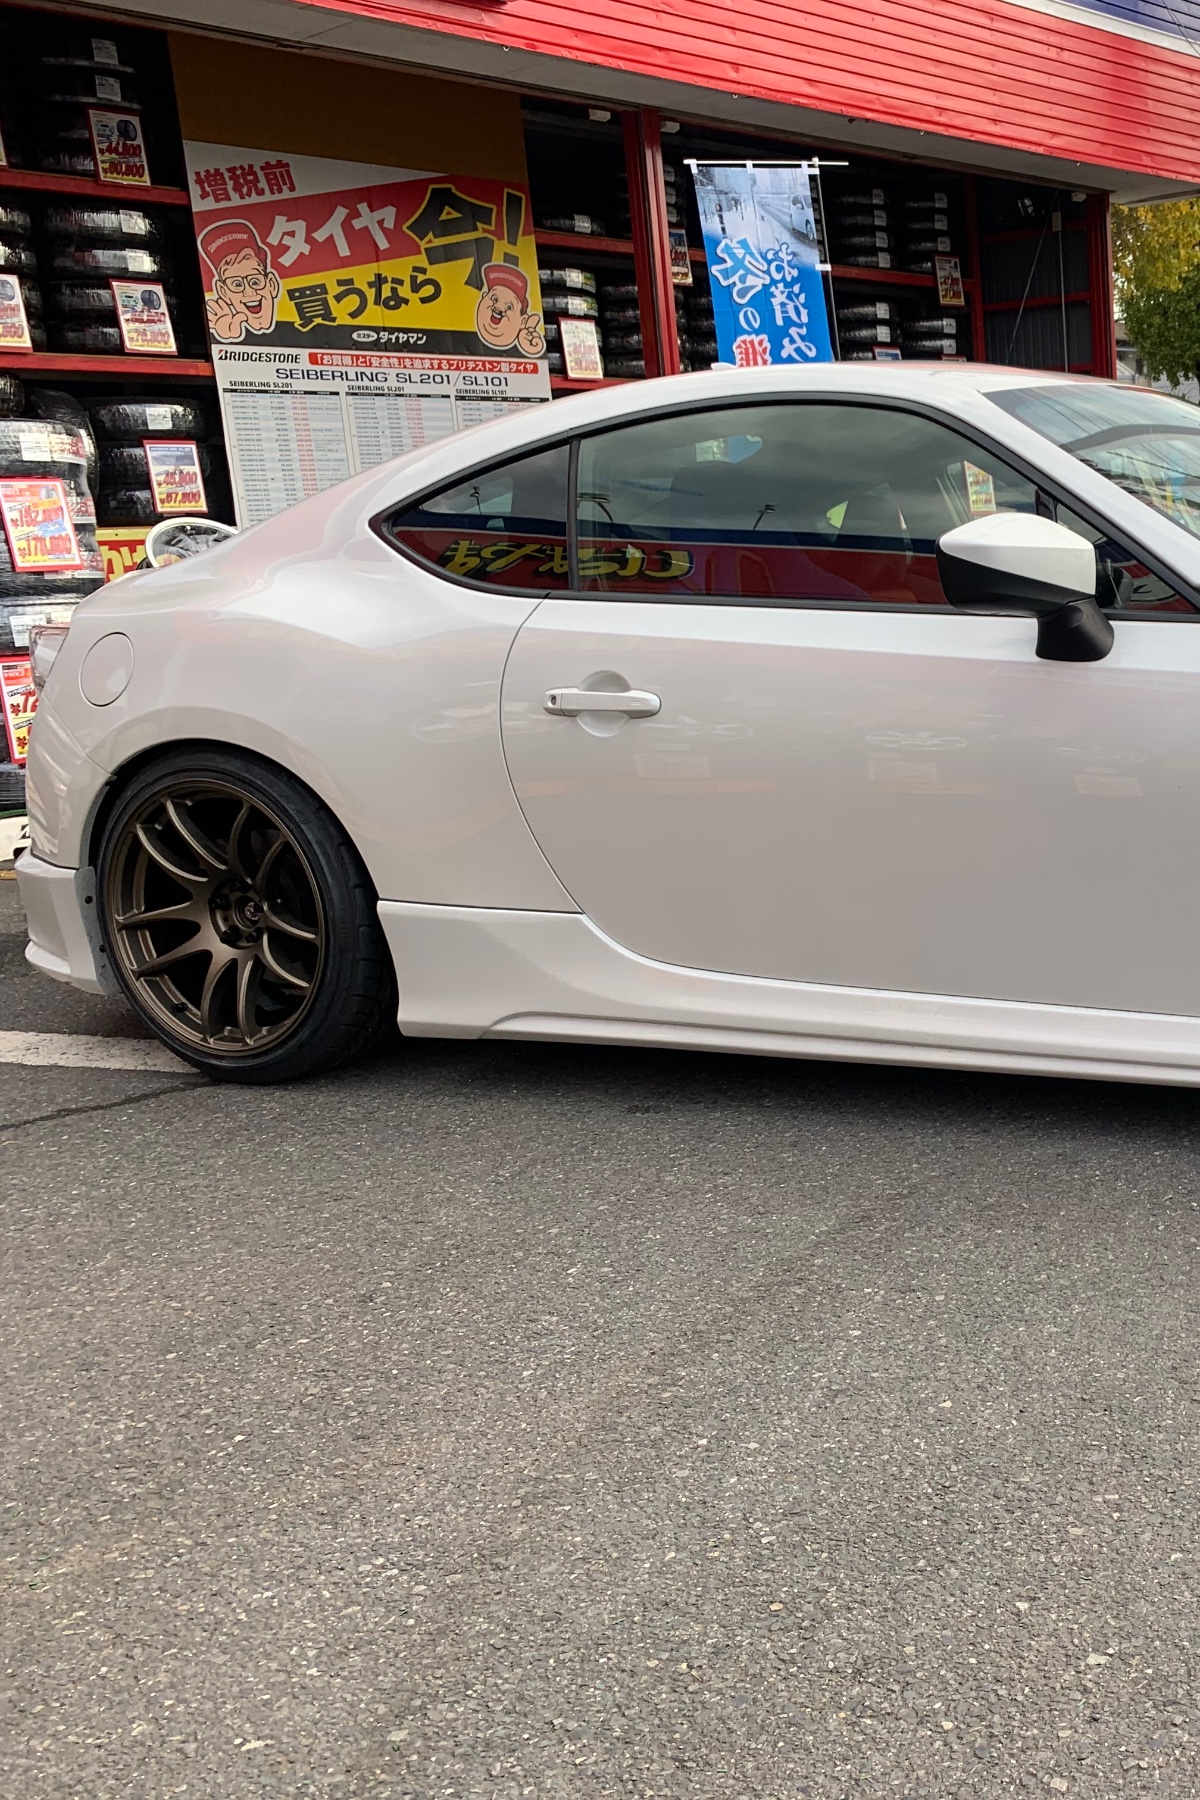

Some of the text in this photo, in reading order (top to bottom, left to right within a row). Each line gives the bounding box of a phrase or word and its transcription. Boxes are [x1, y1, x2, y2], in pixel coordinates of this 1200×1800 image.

[194, 160, 296, 203] 増税前
[266, 202, 397, 267] タイヤ
[286, 265, 442, 328] 買うなら
[379, 331, 427, 344] タイヤマン
[217, 349, 301, 364] BRIDGESTONE
[275, 368, 388, 383] SEIBERLING
[229, 380, 293, 389] SEIBERLING SL201
[347, 384, 386, 392] SEIBERLING
[455, 388, 490, 396] SEIBERLING
